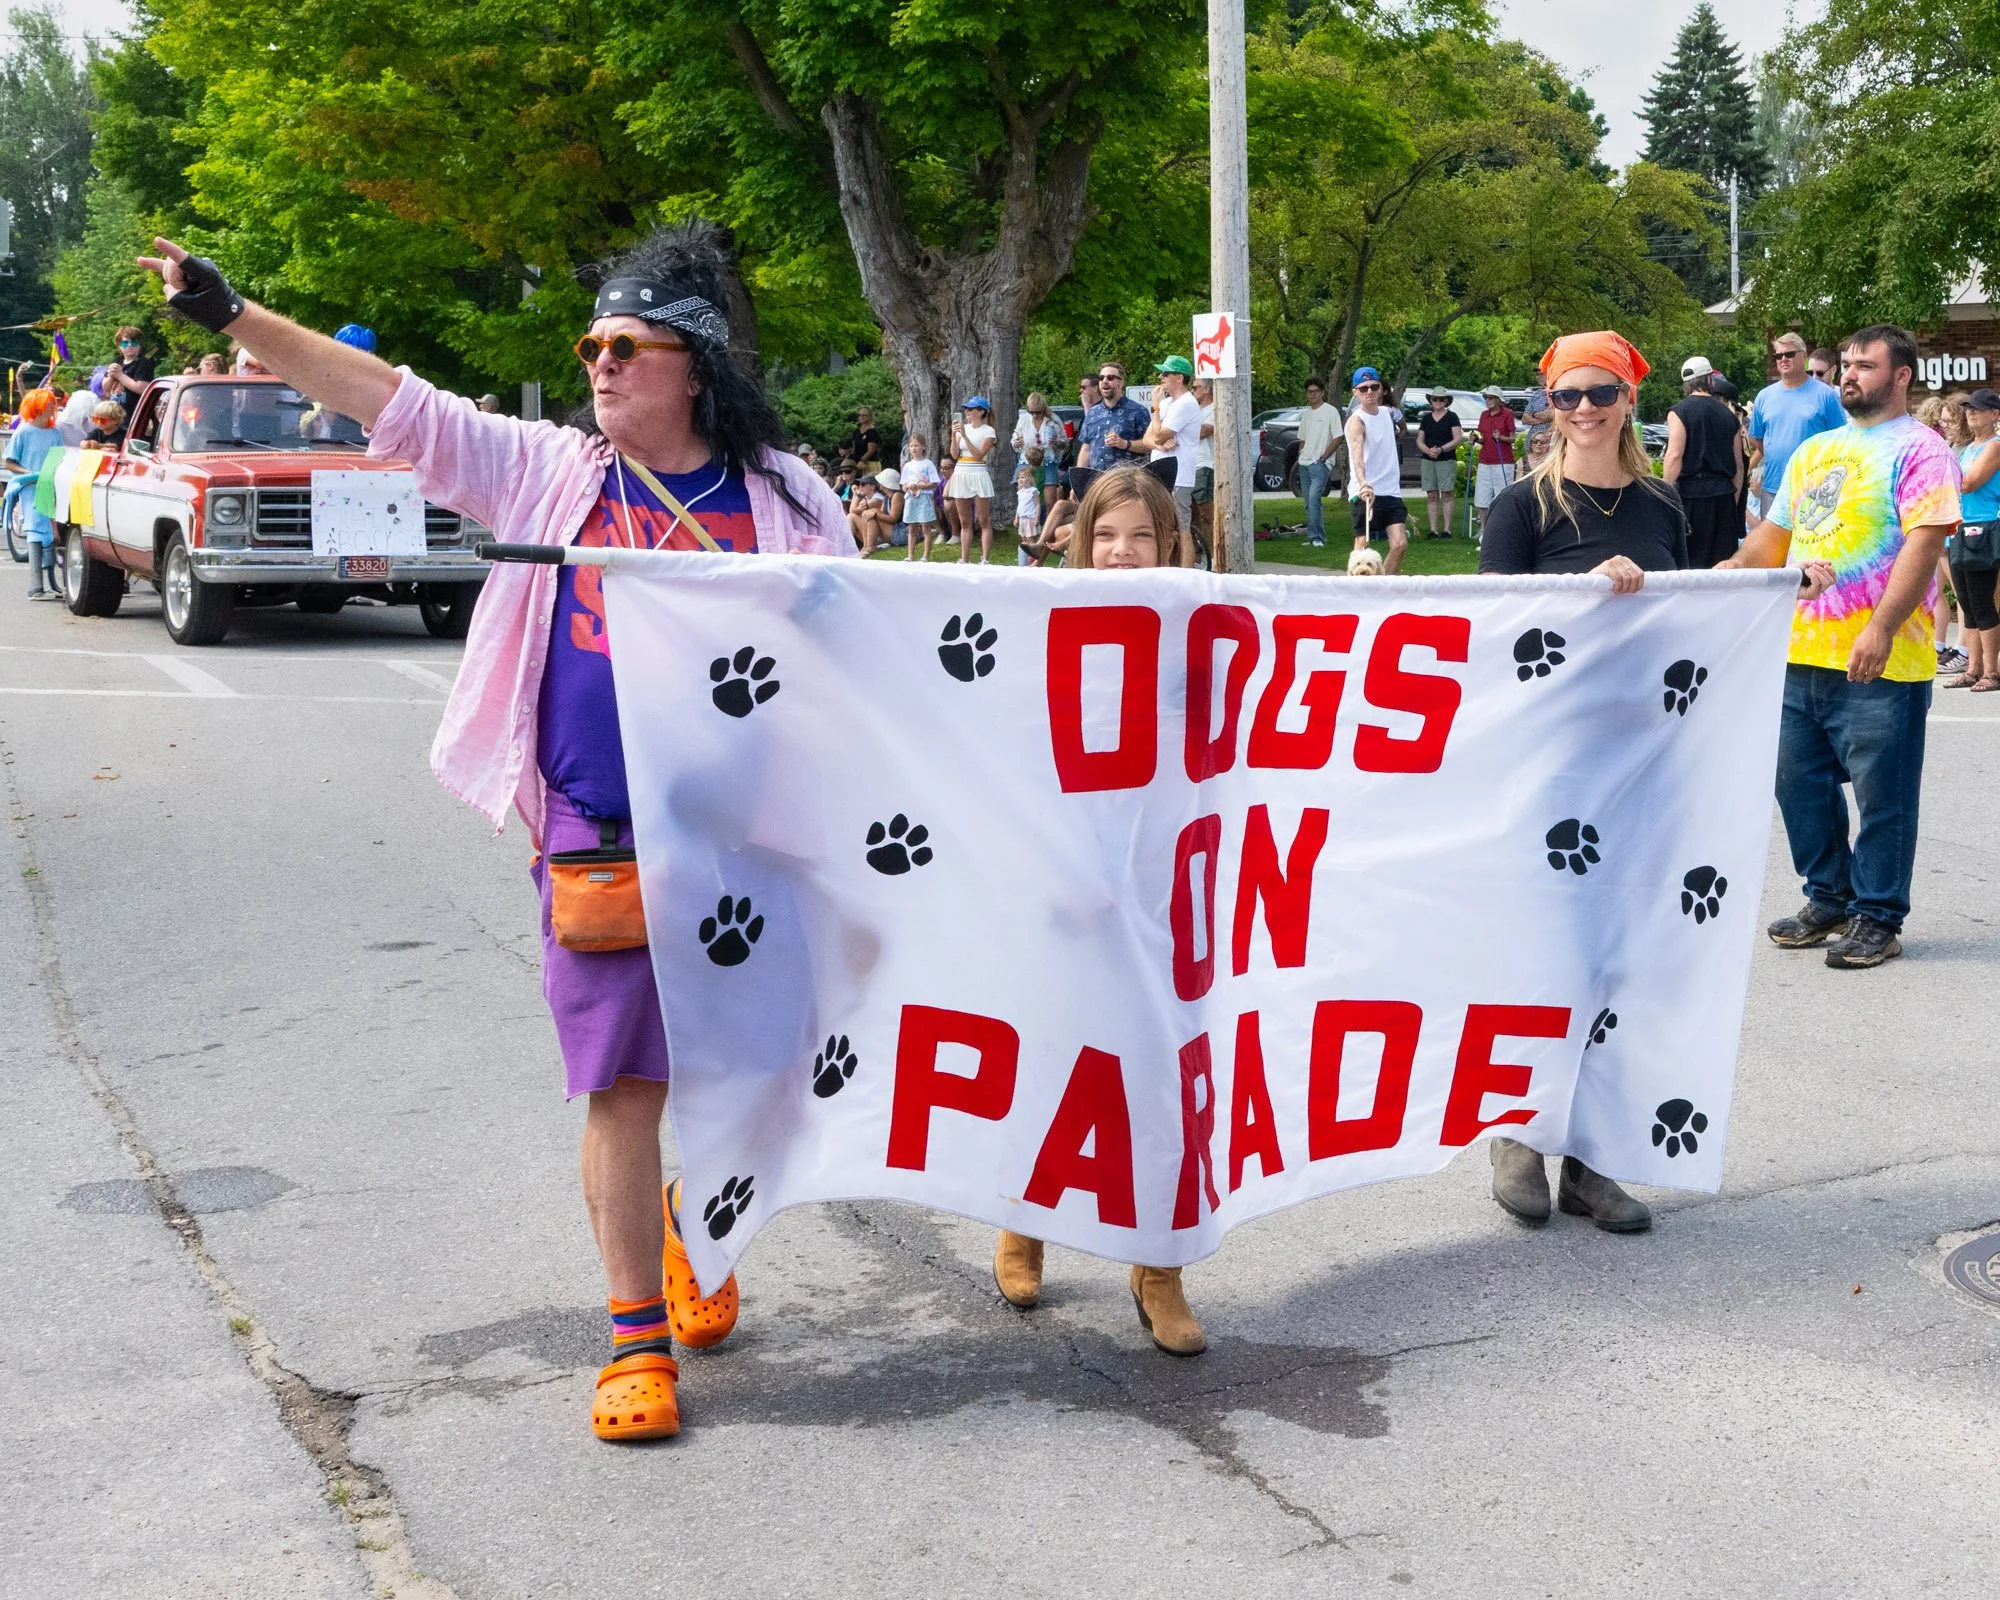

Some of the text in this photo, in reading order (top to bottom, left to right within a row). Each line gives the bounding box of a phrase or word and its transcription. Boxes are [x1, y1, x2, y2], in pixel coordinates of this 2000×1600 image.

[344, 560, 387, 571] E33820
[1046, 603, 1471, 793] DOGS
[1169, 804, 1329, 1001] ON
[886, 1000, 1572, 1230] PARADE
